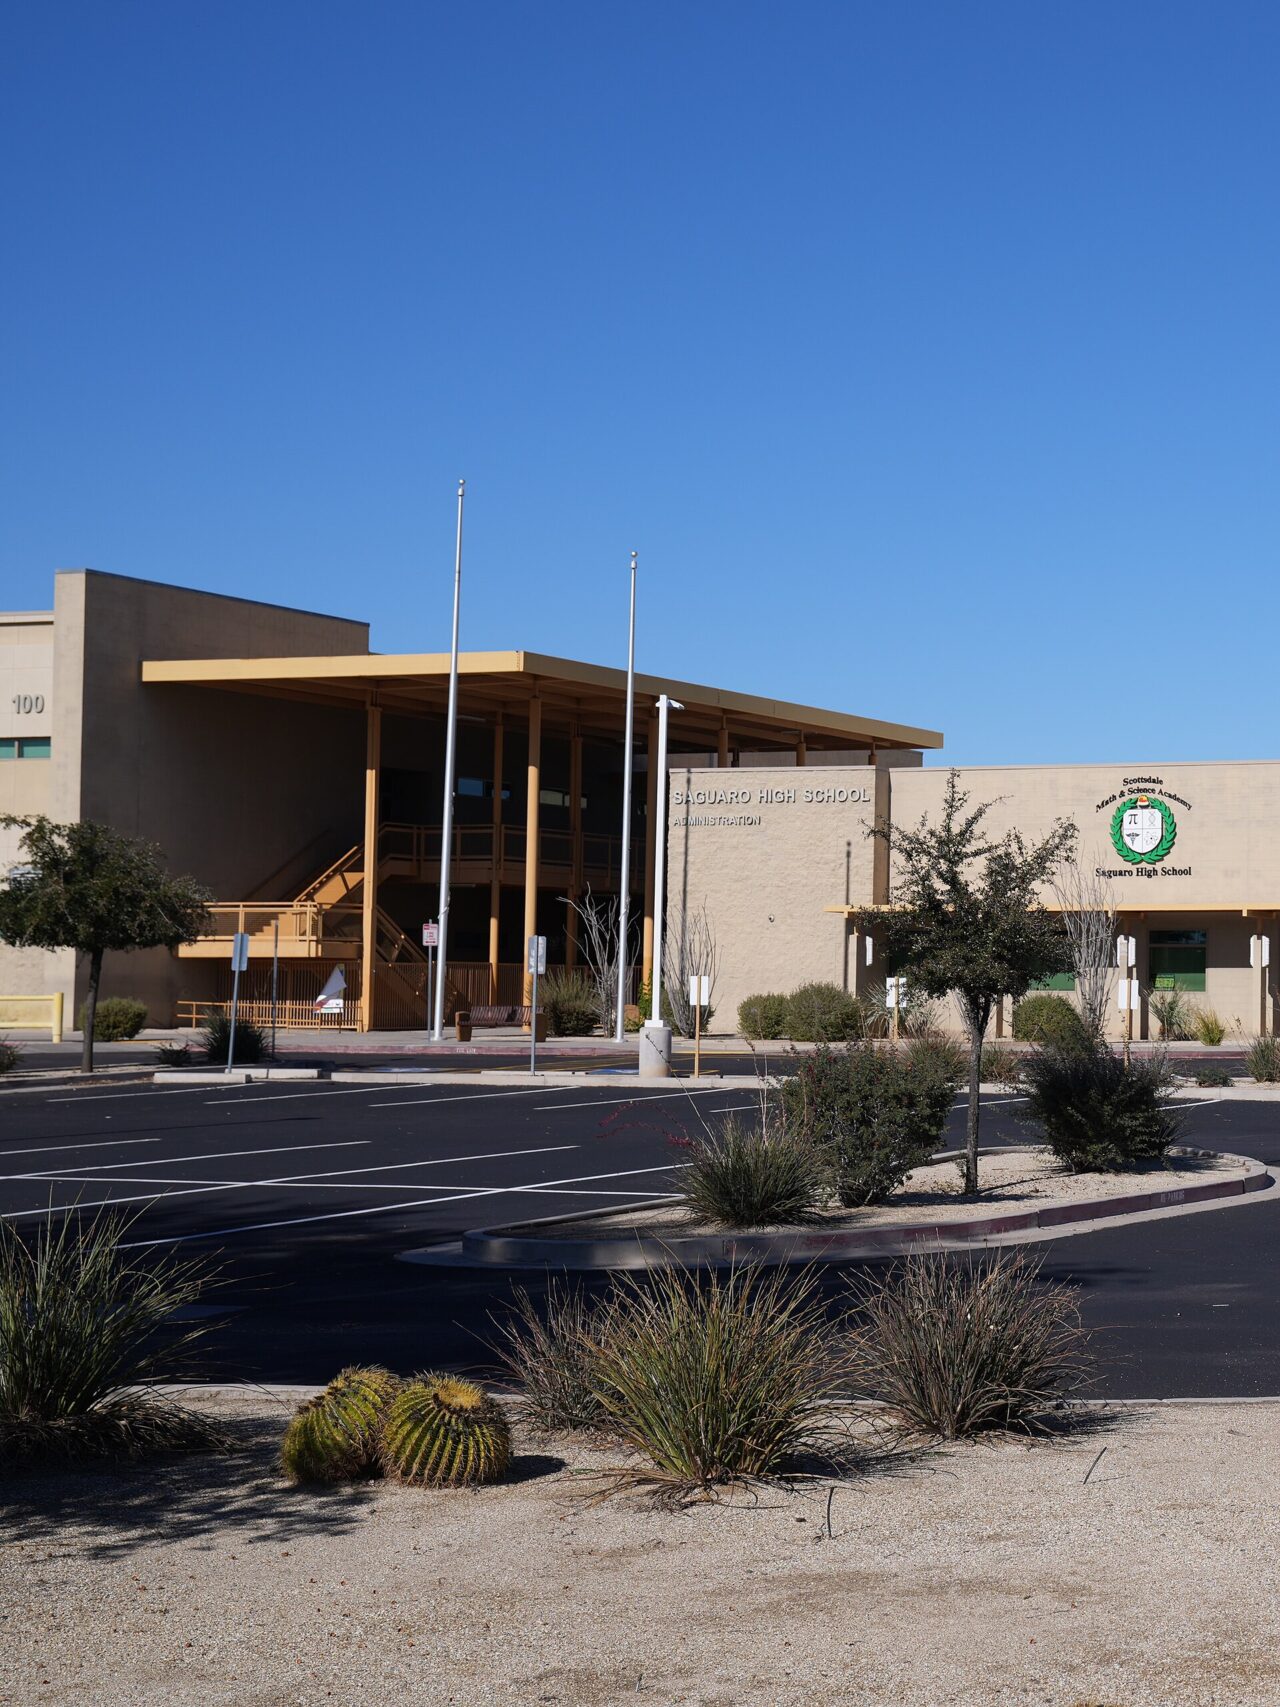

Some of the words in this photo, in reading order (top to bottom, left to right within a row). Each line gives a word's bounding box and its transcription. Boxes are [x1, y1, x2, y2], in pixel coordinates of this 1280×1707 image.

[12, 694, 45, 714] 100
[1122, 776, 1164, 787] Scottsdale
[673, 790, 751, 805] SAGUARO
[758, 788, 796, 804] HIGH
[803, 787, 870, 803] SCHOOL
[1095, 793, 1117, 813] Math
[1118, 790, 1126, 799] &
[1127, 786, 1156, 796] Science
[1157, 788, 1193, 811] Academy
[673, 815, 761, 827] ADMINISTRATION
[1095, 867, 1133, 879] Saguaro
[1136, 867, 1158, 879] High
[1161, 867, 1192, 876] School
